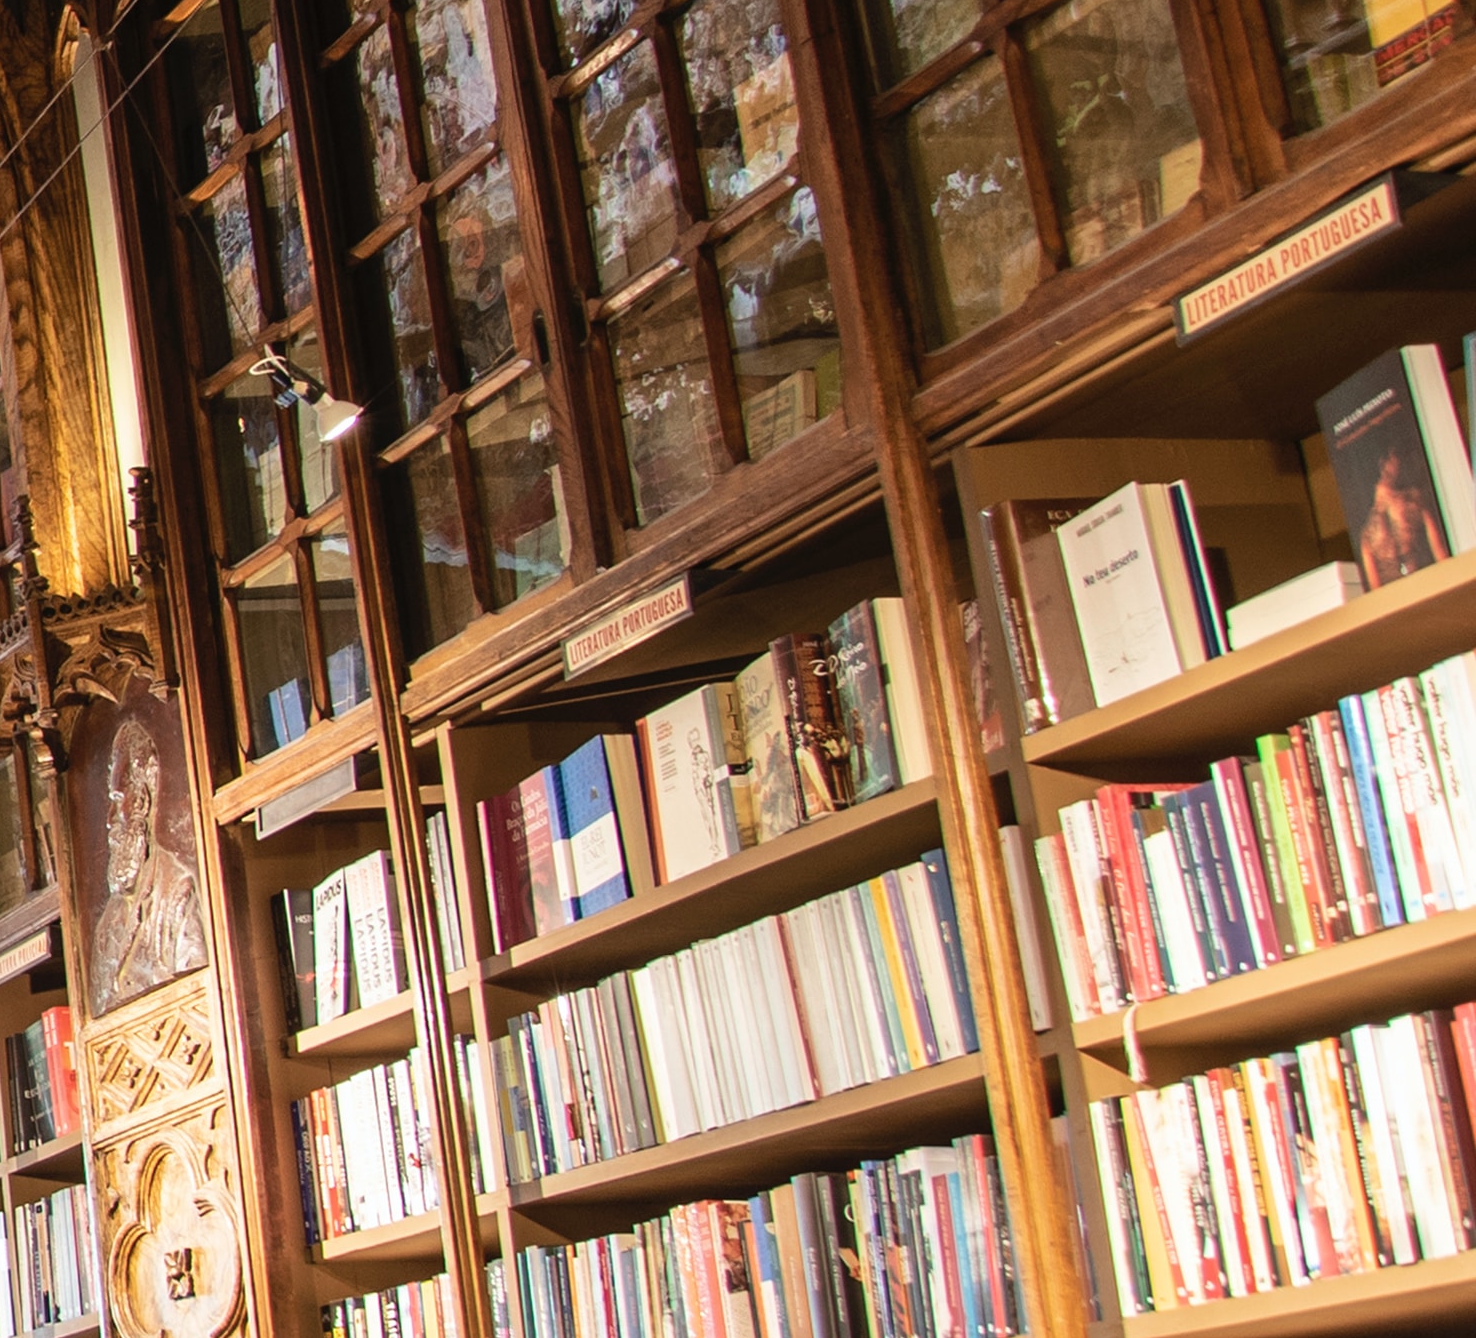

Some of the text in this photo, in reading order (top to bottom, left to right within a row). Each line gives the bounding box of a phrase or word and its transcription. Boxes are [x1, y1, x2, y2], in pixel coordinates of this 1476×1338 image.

[1185, 196, 1383, 326] LITERATURA PORTUGUESA
[1109, 548, 1139, 575] deserto
[569, 587, 685, 665] LITERATURA PORTUGUESA
